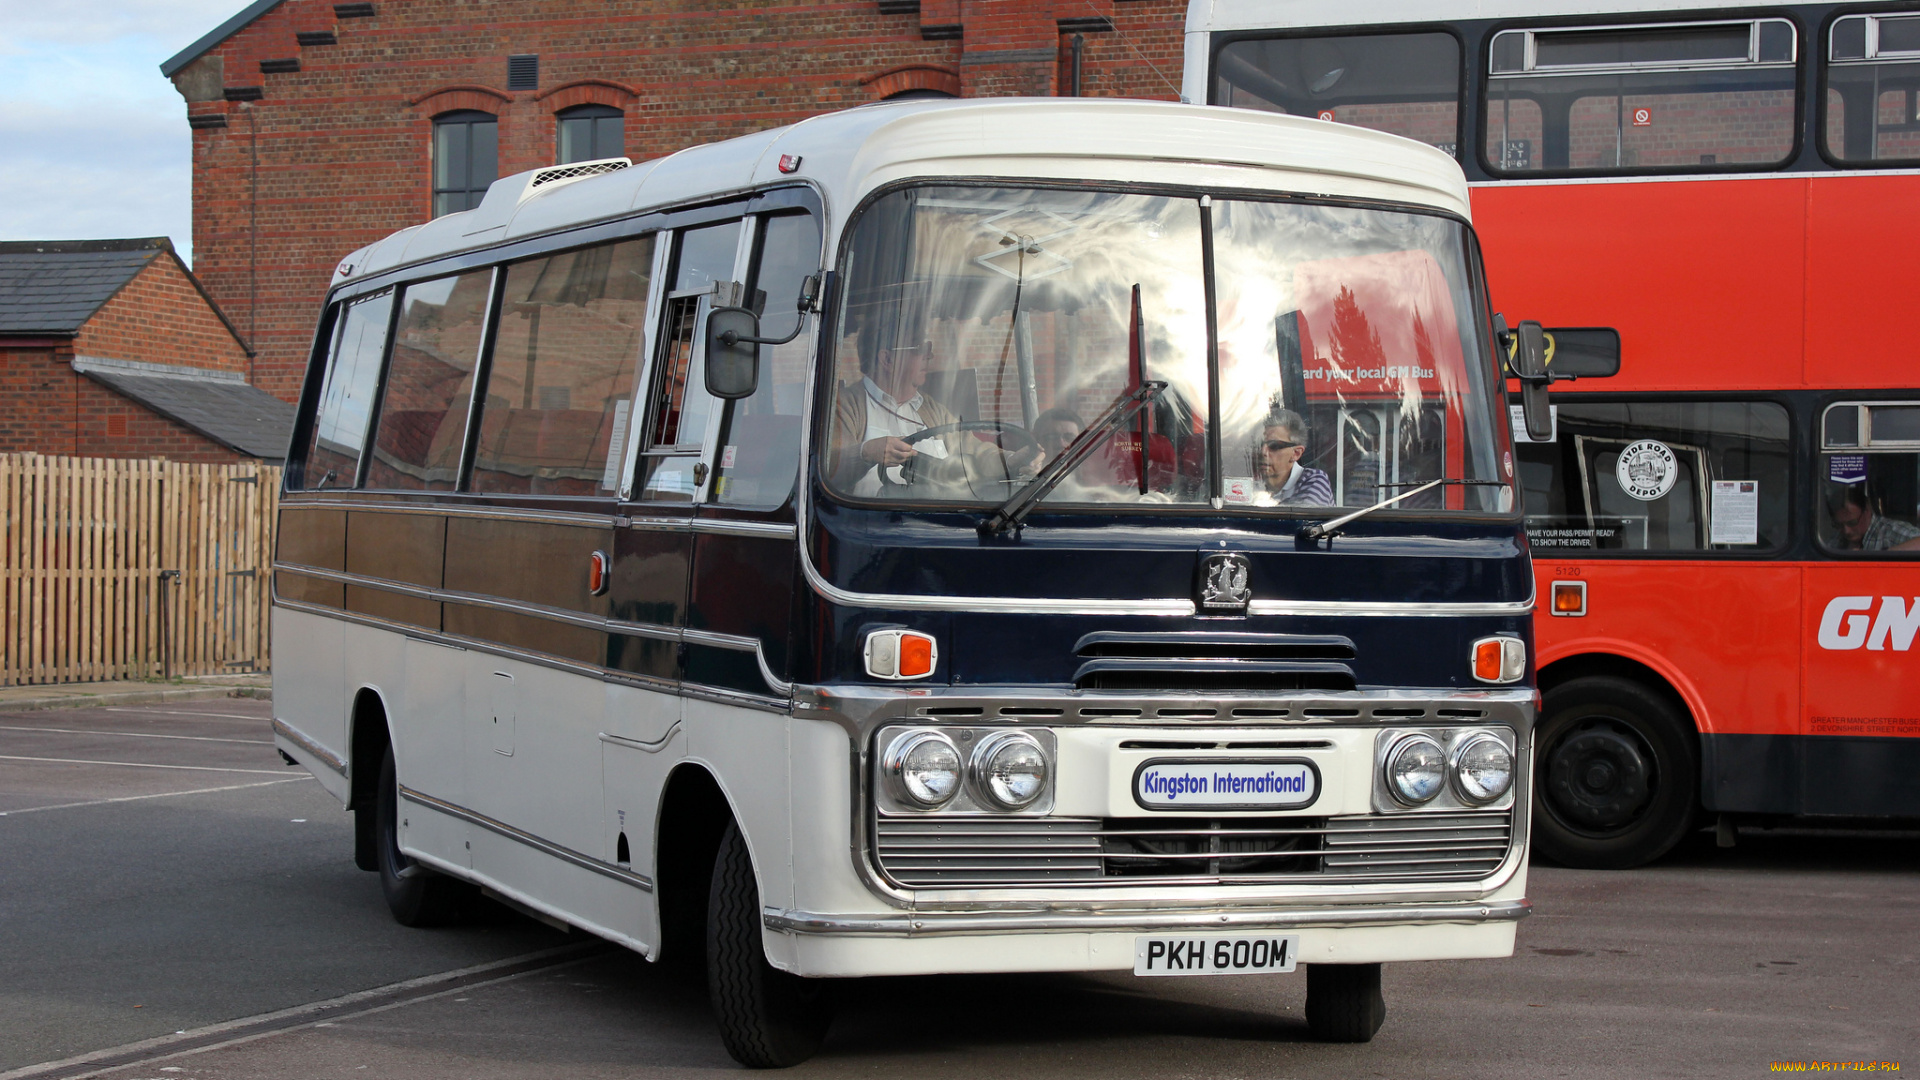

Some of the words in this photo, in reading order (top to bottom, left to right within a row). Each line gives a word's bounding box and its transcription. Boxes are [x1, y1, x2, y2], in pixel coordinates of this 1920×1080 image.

[1326, 368, 1354, 382] your
[1357, 366, 1385, 379] local
[1387, 366, 1409, 379] GM
[1411, 366, 1434, 379] Bus
[1622, 444, 1643, 464] HYDE
[1646, 443, 1671, 462] ROAD
[1629, 485, 1662, 496] DEPOT
[1526, 529, 1541, 537] HAVE
[1542, 529, 1558, 537] YOUR
[1558, 529, 1595, 537] PASS/PERMIT
[1596, 529, 1615, 537] READY
[1555, 567, 1581, 576] 5120
[1810, 716, 1845, 724] GREATER
[1847, 717, 1900, 725] MANCHESTER
[1816, 725, 1864, 733] DEVONSHIRE
[1866, 725, 1896, 733] STREET
[1144, 771, 1208, 799] Kingston
[1213, 770, 1306, 793] International
[1147, 941, 1205, 969] PKH
[1213, 939, 1288, 968] 600M
